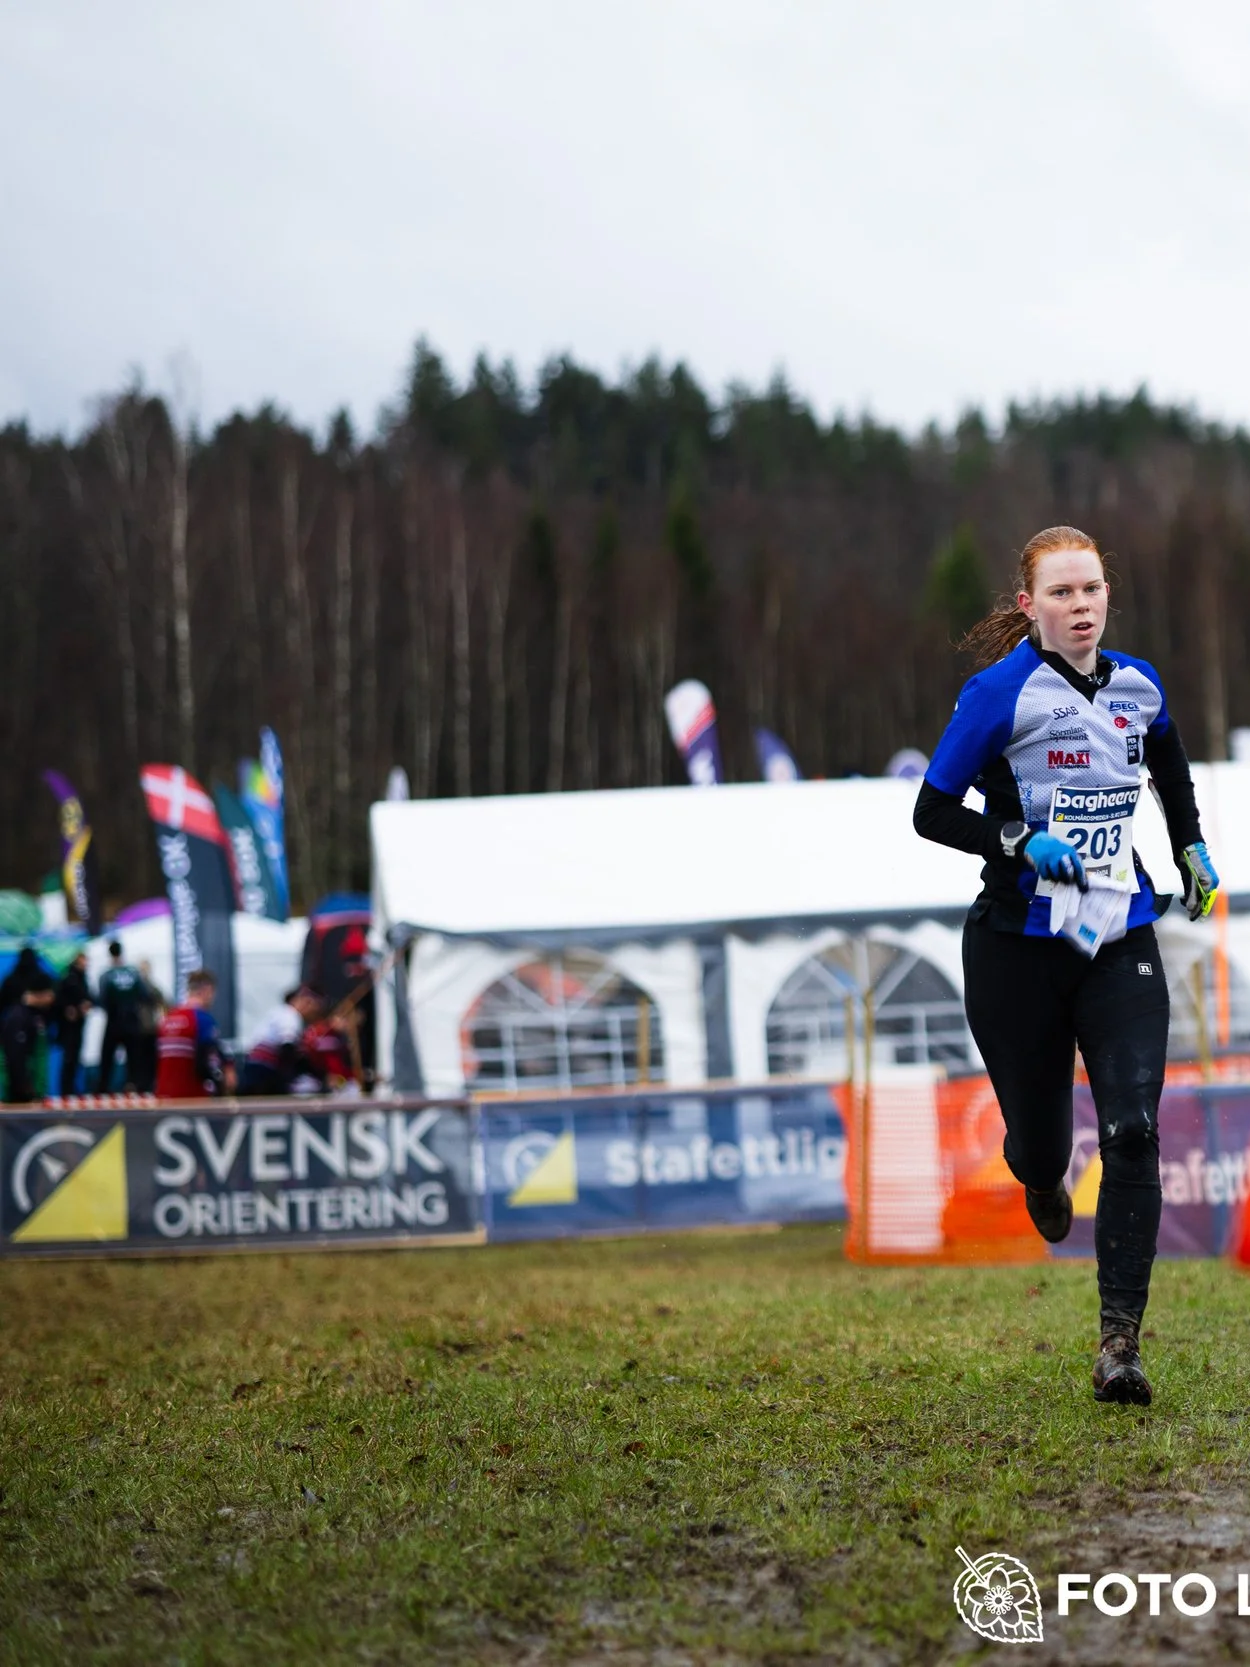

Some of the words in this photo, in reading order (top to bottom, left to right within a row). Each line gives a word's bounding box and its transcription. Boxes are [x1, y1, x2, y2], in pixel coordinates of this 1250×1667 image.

[1053, 706, 1079, 720] SSAB
[1055, 790, 1139, 812] bagheera
[1066, 824, 1122, 860] 203
[154, 1107, 445, 1187] SVENSK
[154, 1181, 450, 1238] ORIENTERING
